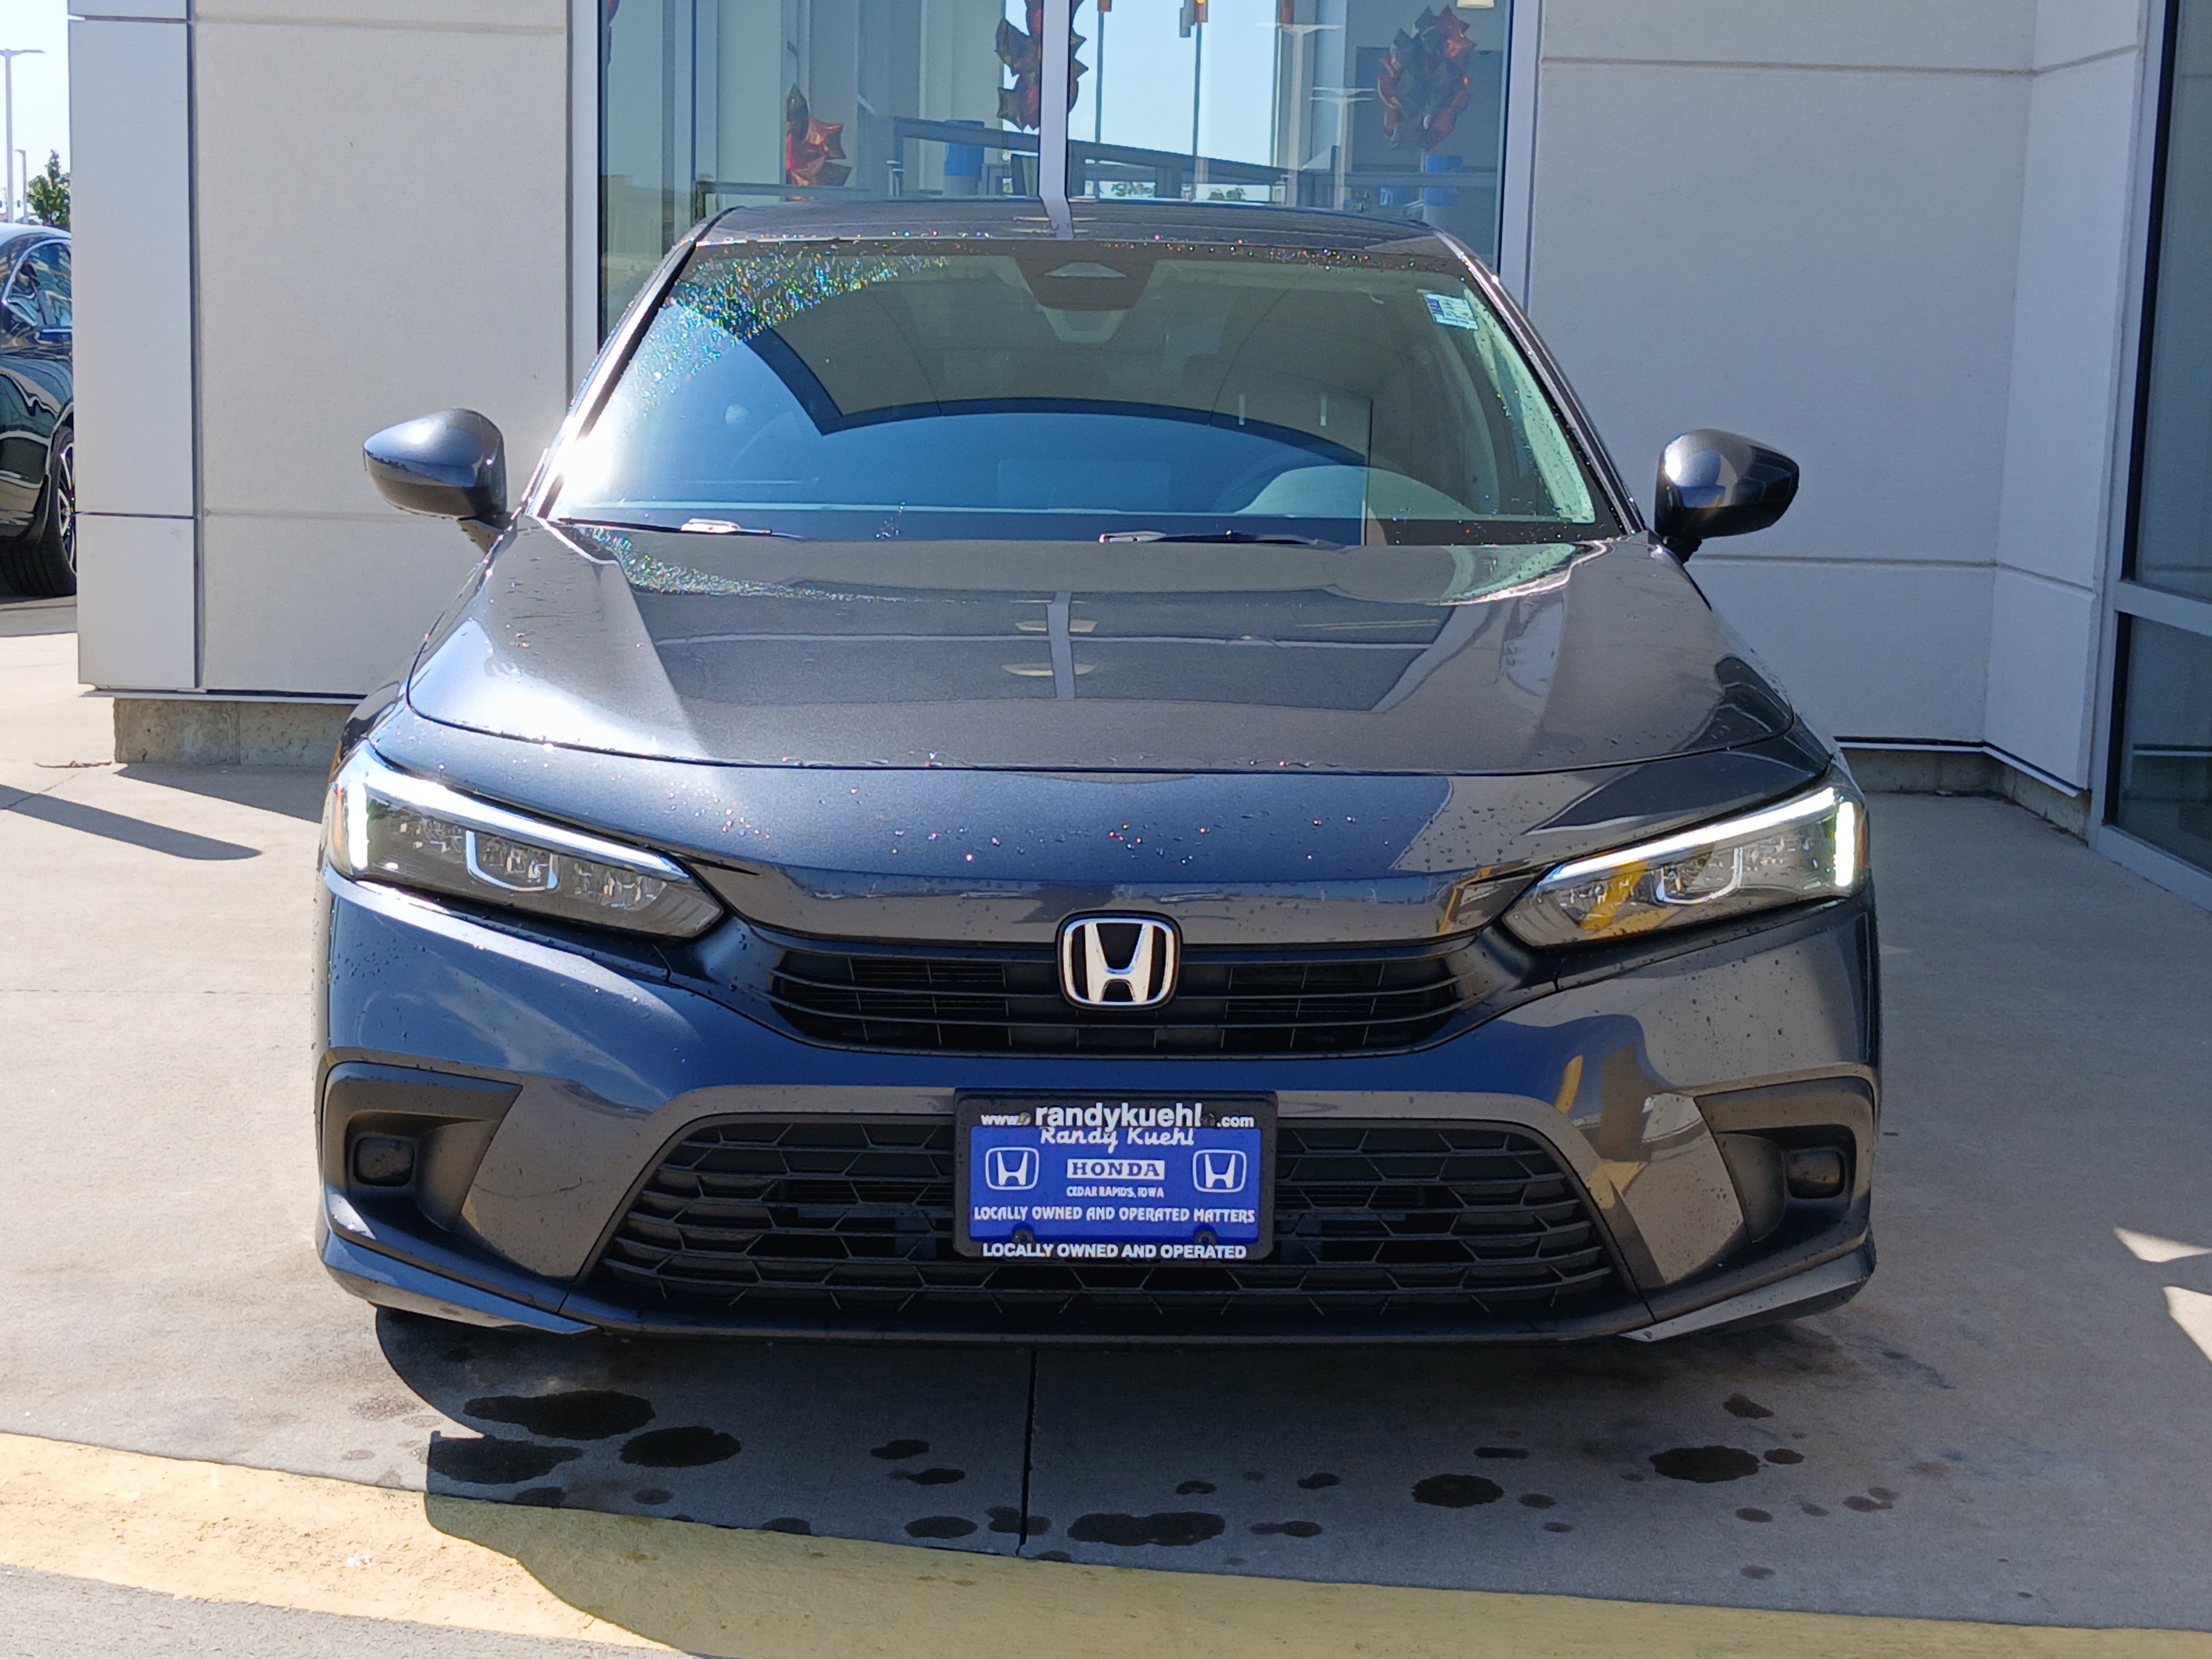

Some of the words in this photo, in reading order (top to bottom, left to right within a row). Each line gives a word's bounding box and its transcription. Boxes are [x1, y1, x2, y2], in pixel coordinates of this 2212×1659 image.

[1035, 1102, 1202, 1132] randykuehl
[1216, 1116, 1255, 1128] .com
[1039, 1126, 1118, 1154] Randy
[1127, 1127, 1194, 1146] Kuehl
[1071, 1162, 1160, 1176] HONDA
[1066, 1186, 1097, 1197] CEDAR
[1099, 1186, 1136, 1198] RAPIDS,
[1138, 1187, 1164, 1198] IOWA
[974, 1206, 1028, 1221] LOCALLY
[1032, 1206, 1082, 1220] OWNED
[1086, 1207, 1115, 1221] AND
[1118, 1207, 1190, 1222] OPERATED
[1194, 1208, 1255, 1224] MATTERS
[983, 1243, 1054, 1257] LOCALLY
[1057, 1244, 1118, 1258] OWNED
[1121, 1244, 1156, 1258] AND
[1160, 1245, 1246, 1259] OPERATED
